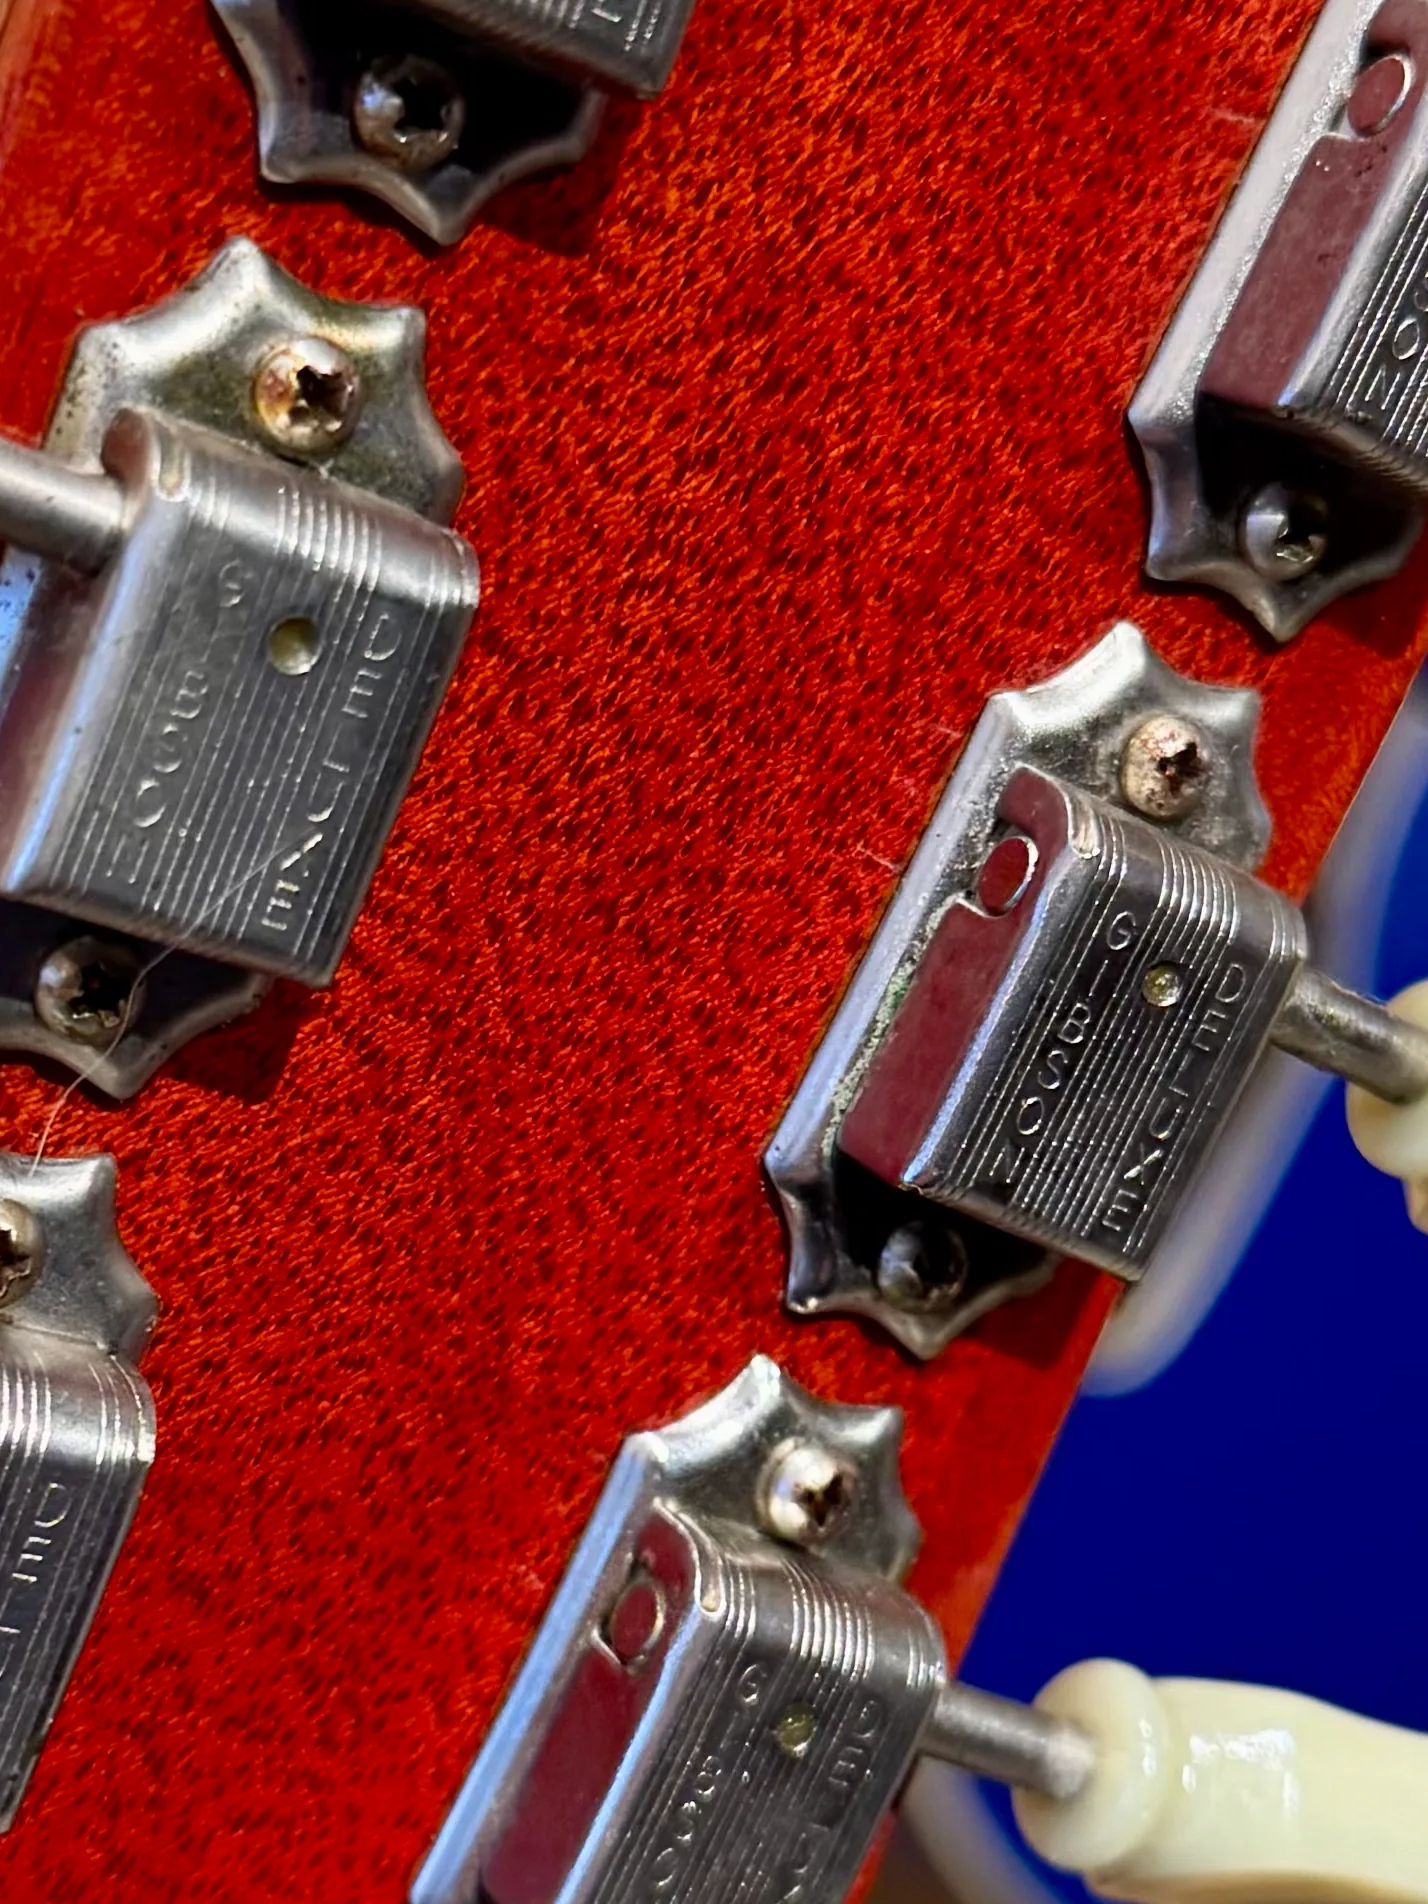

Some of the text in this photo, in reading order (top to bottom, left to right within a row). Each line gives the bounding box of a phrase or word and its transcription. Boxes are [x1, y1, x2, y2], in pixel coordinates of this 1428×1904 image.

[261, 612, 402, 931] DELUXE
[990, 910, 1138, 1184] GIBSON
[1102, 962, 1245, 1233] DELUXE
